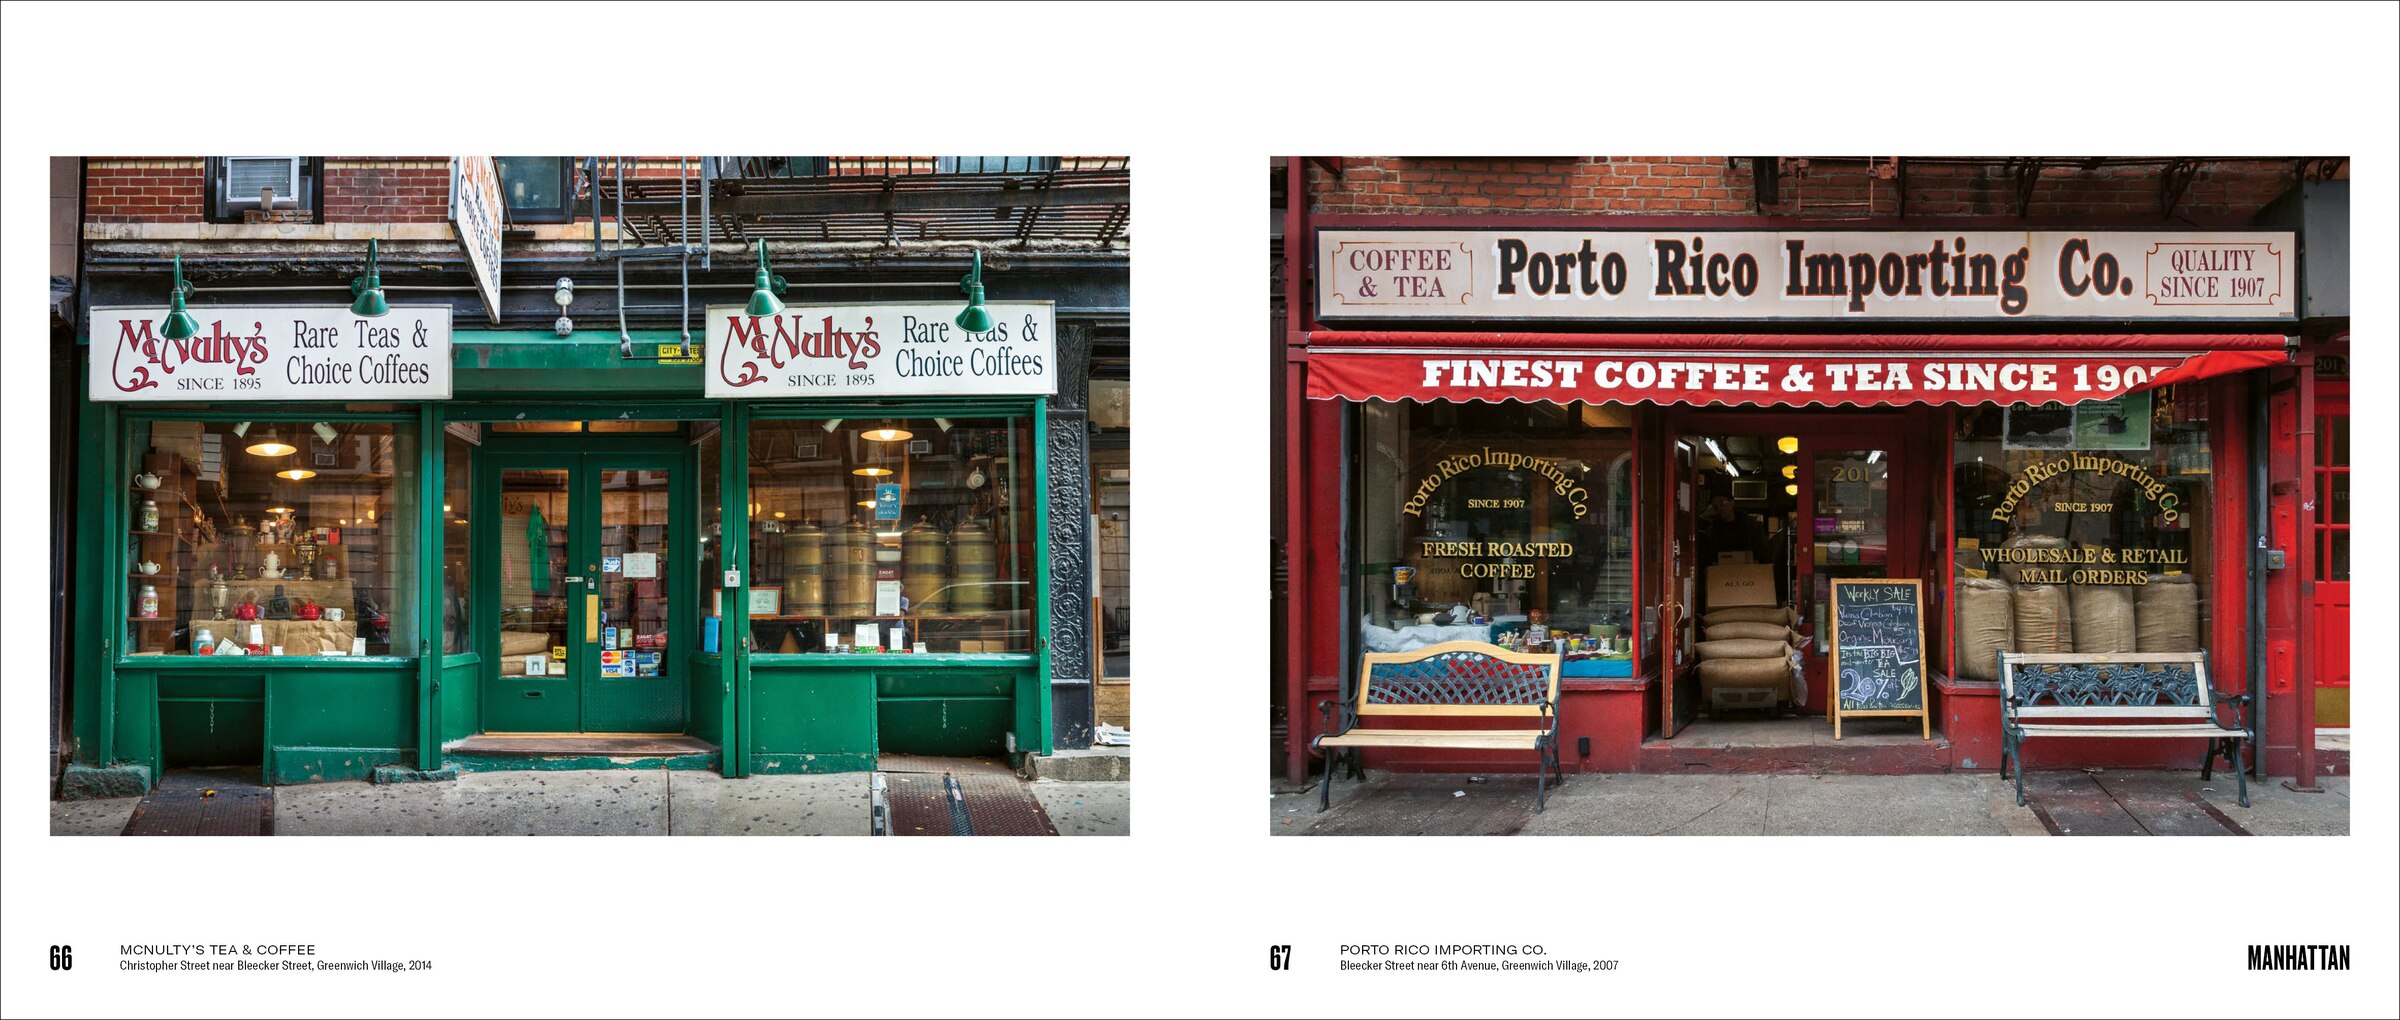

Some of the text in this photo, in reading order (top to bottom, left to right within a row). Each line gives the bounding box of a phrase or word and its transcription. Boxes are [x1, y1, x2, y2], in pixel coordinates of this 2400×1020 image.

[1350, 249, 1452, 271] COFFEE
[2171, 249, 2256, 273] QUALITY
[1358, 276, 1446, 298] & TEA
[1497, 236, 2134, 316] Porto Rico Importing Co.
[2160, 276, 2266, 299] SINCE 1907
[293, 319, 429, 349] Rare Teas &
[903, 315, 949, 344] Rare
[1022, 314, 1039, 343] &
[112, 319, 269, 393] McNulty's
[720, 314, 881, 388] McNulty's
[896, 346, 1043, 378] Choice Coffees
[286, 354, 430, 386] Choice Coffees
[788, 374, 876, 388] SINCE 1895
[1421, 359, 1583, 388] FINEST
[1594, 361, 1770, 391] COFFEE
[1781, 364, 1816, 392] &
[1825, 363, 1912, 391] TEA
[1923, 363, 2058, 391] SINCE
[177, 377, 262, 391] SINCE 1895
[1403, 447, 1588, 521] Porto Rico Importing Co.
[1832, 466, 1870, 483] 201
[1991, 451, 2180, 526] Porto Rico Importing Co.
[1468, 499, 1525, 509] SINCE 1907
[2054, 502, 2113, 513] SINCE 1907
[1422, 541, 1574, 558] FRESH ROASTED
[1980, 547, 2188, 565] WHOLESALE & RETAIL
[1460, 563, 1536, 579] COFFEE
[2019, 569, 2149, 585] MAIL ORDERS
[1884, 586, 1911, 602] SALE
[1863, 649, 1880, 659] BIG
[1880, 649, 1896, 659] BIG
[1873, 668, 1896, 678] SALE
